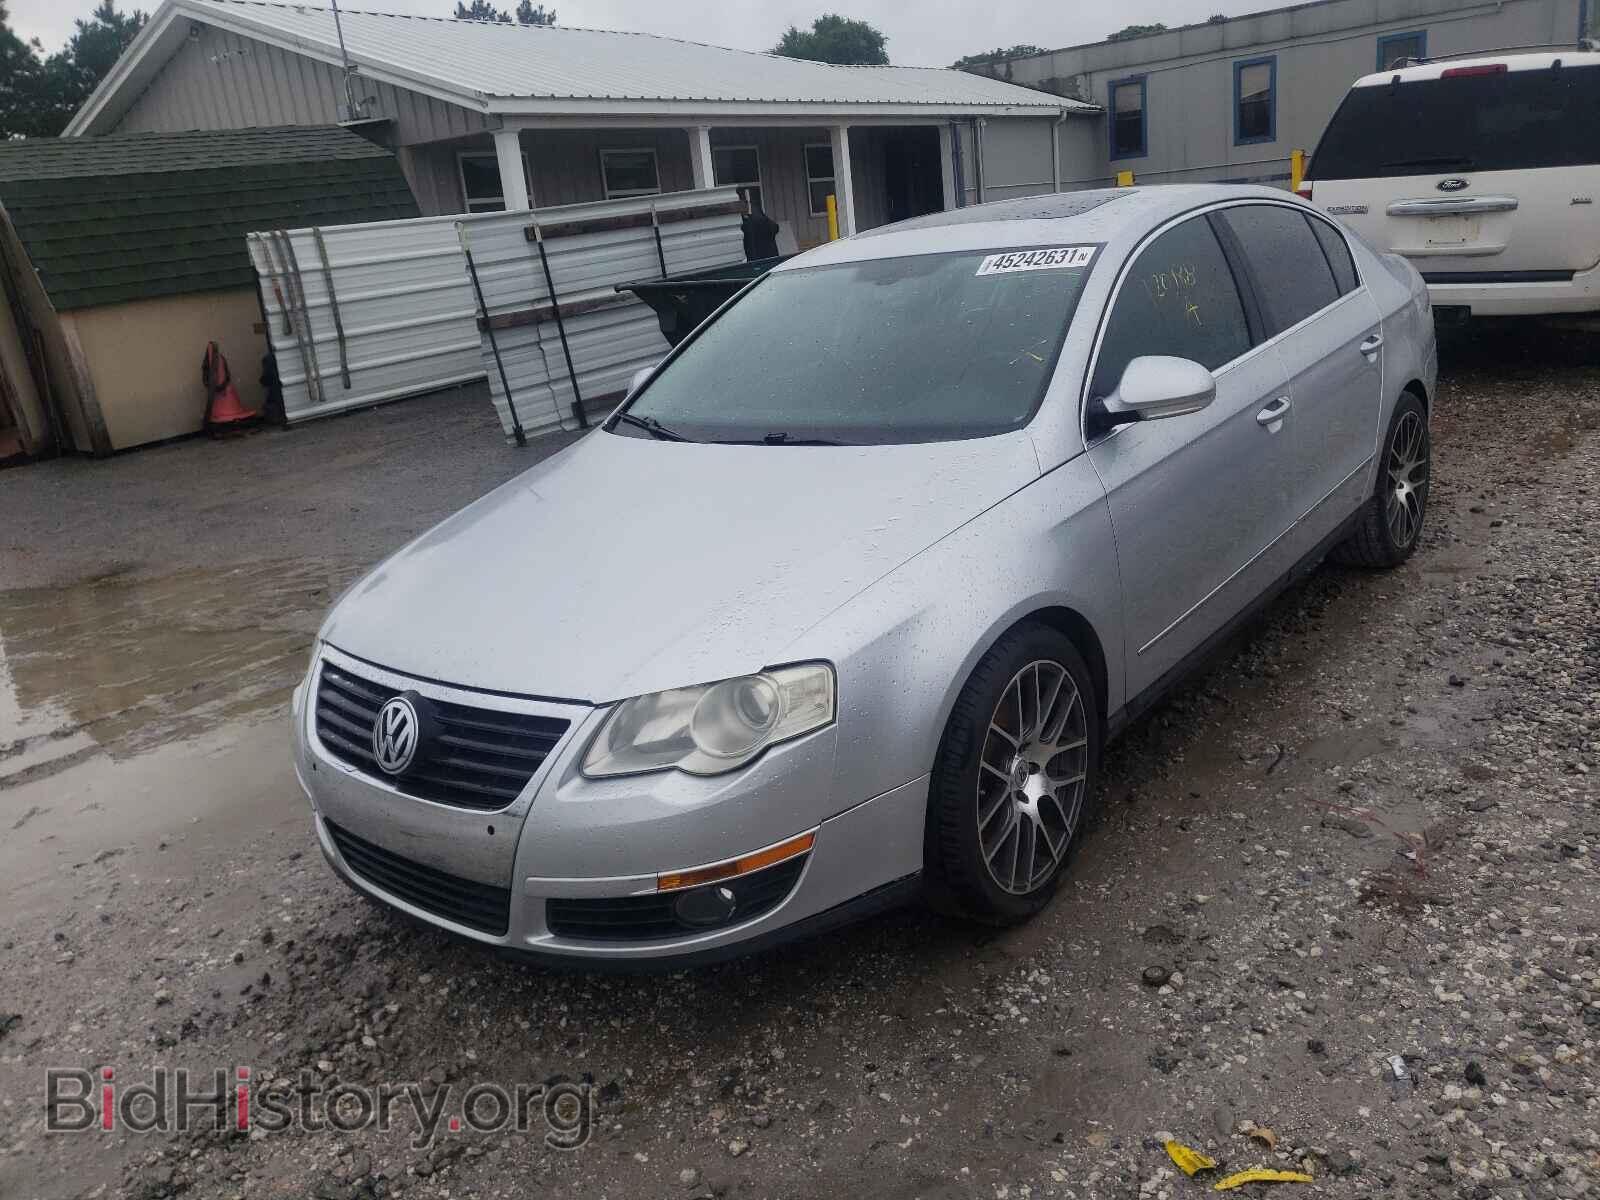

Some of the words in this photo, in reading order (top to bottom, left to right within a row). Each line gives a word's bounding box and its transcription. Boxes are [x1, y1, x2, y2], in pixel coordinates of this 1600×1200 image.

[1439, 179, 1466, 191] Ford
[993, 248, 1079, 269] 45242631
[1079, 252, 1088, 261] N
[378, 699, 416, 771] VW
